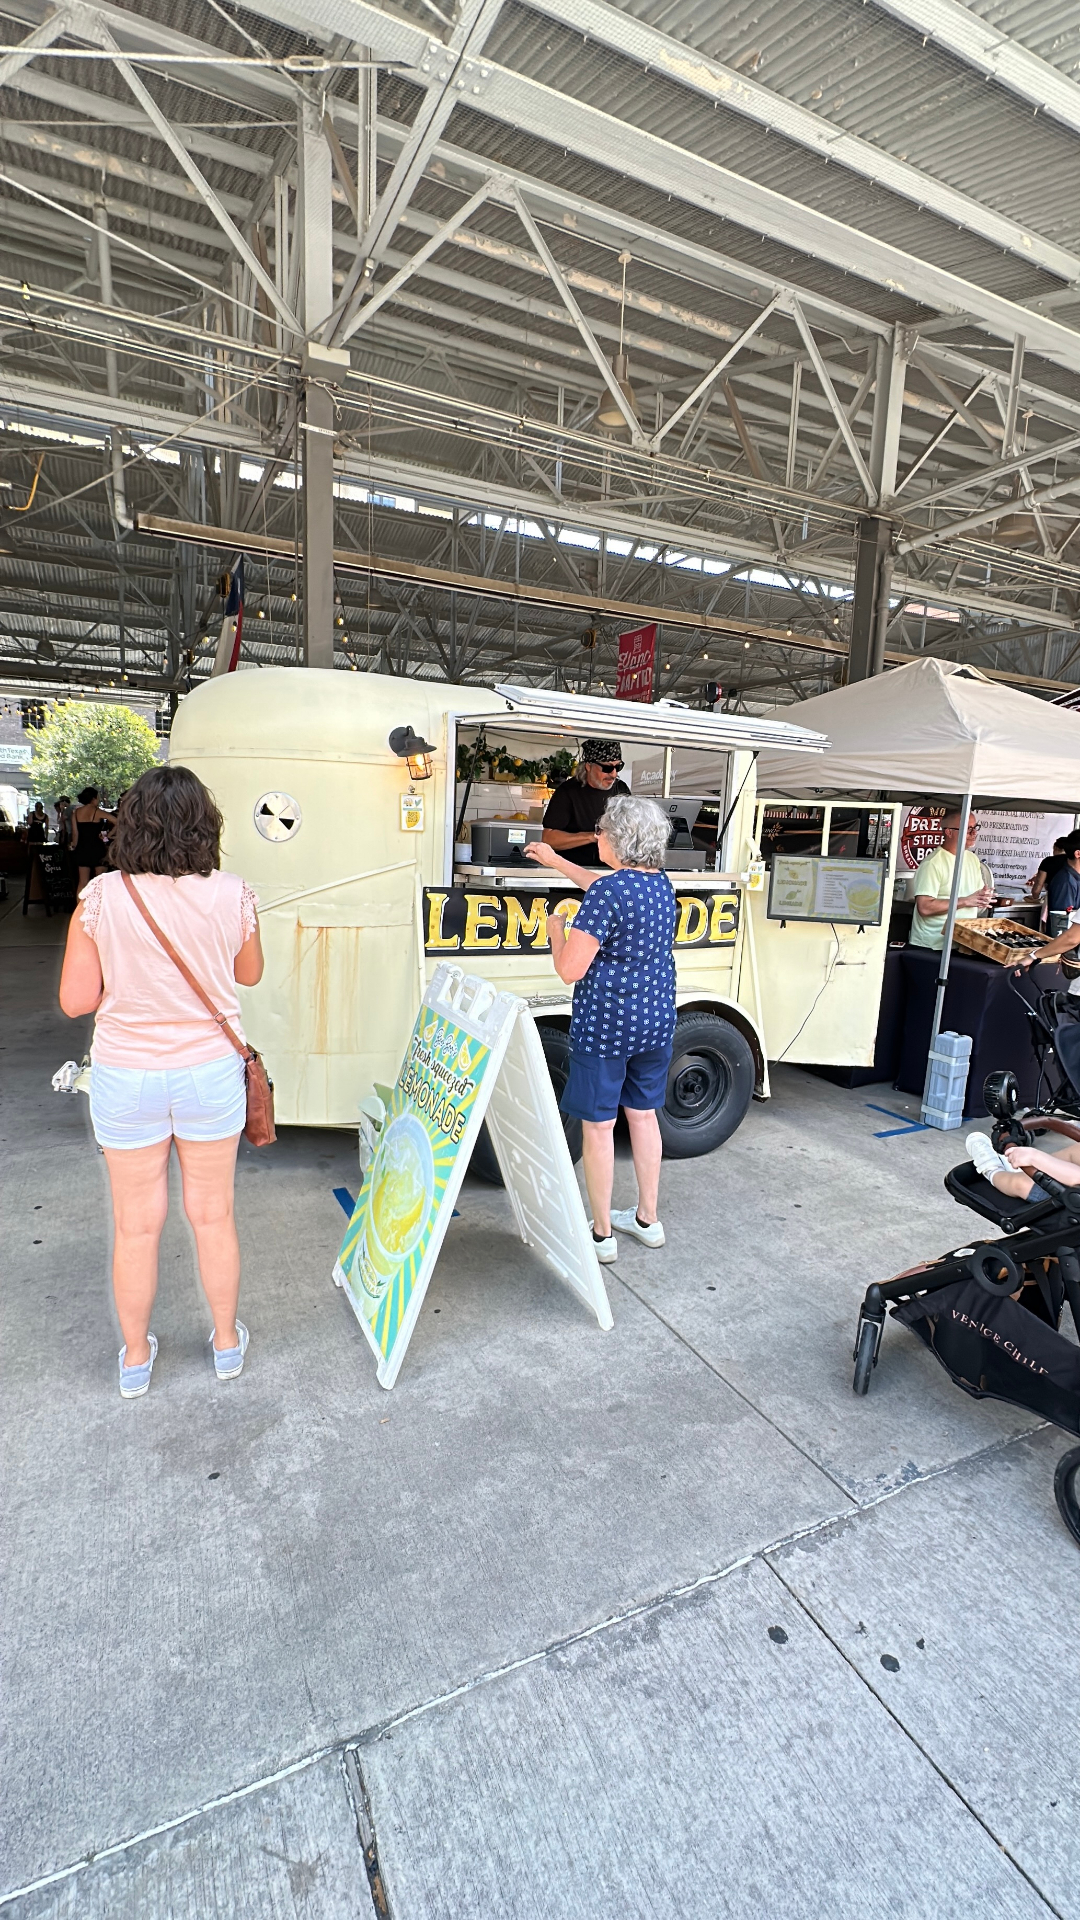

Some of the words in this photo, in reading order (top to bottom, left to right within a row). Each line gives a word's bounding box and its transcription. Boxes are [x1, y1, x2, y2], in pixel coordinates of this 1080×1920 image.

[640, 769, 677, 782] Acady
[910, 818, 942, 831] BRE
[989, 822, 1029, 831] PRESERVATIVES
[979, 835, 1008, 843] NATURALLY
[978, 848, 995, 856] BAKED
[996, 849, 1012, 857] FRESH
[1013, 850, 1027, 858] DAILY
[431, 1059, 474, 1097] squeezed
[398, 1062, 466, 1145] LEMONADE
[952, 1309, 1001, 1344] VENICE
